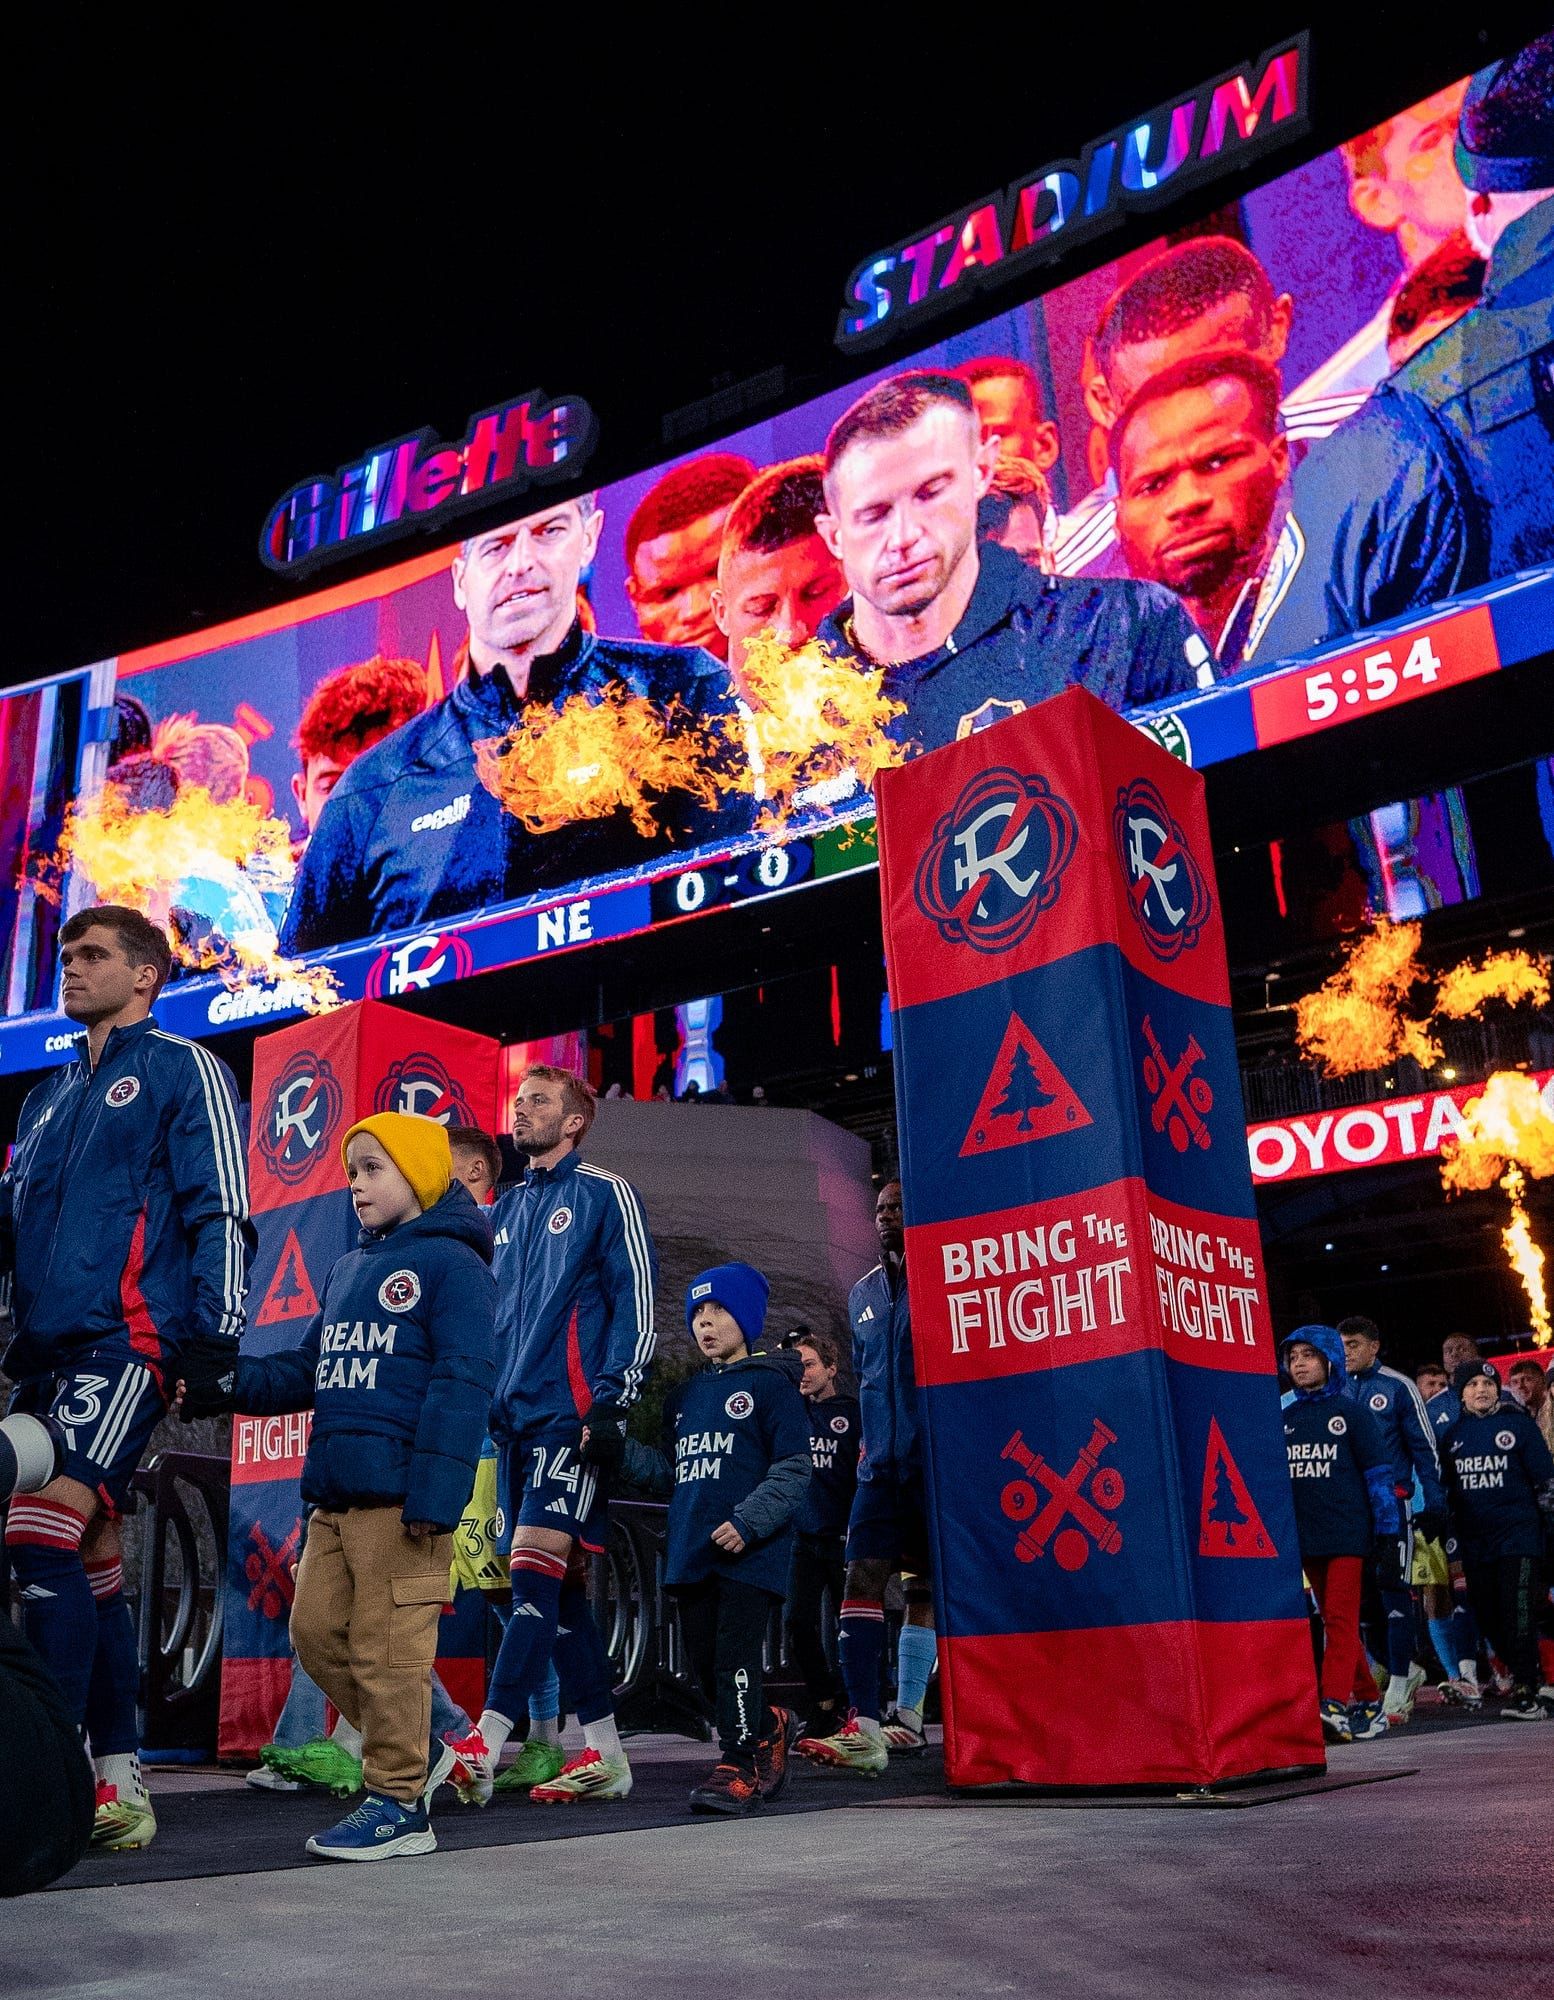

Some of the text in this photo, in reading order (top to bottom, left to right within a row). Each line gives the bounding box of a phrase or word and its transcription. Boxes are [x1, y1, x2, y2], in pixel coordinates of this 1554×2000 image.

[844, 48, 1300, 336] STADIUM
[268, 402, 580, 562] Gillette
[1305, 636, 1441, 721] 5:54
[676, 871, 705, 911] 0
[758, 847, 789, 888] 0
[537, 900, 594, 951] NE
[1247, 1095, 1468, 1178] OYOTA
[941, 1213, 1128, 1285] BRING THE
[1150, 1212, 1256, 1279] BRING THE
[946, 1256, 1131, 1354] FIGHT
[1155, 1264, 1260, 1346] FIGHT
[320, 1321, 398, 1355] REAM
[58, 1374, 109, 1426] 3
[237, 1408, 315, 1465] FIGH
[809, 1437, 838, 1454] EAM
[812, 1453, 833, 1469] AM
[1455, 1455, 1508, 1474] DREAM
[532, 1446, 581, 1494] 14
[1460, 1472, 1504, 1490] TEAM
